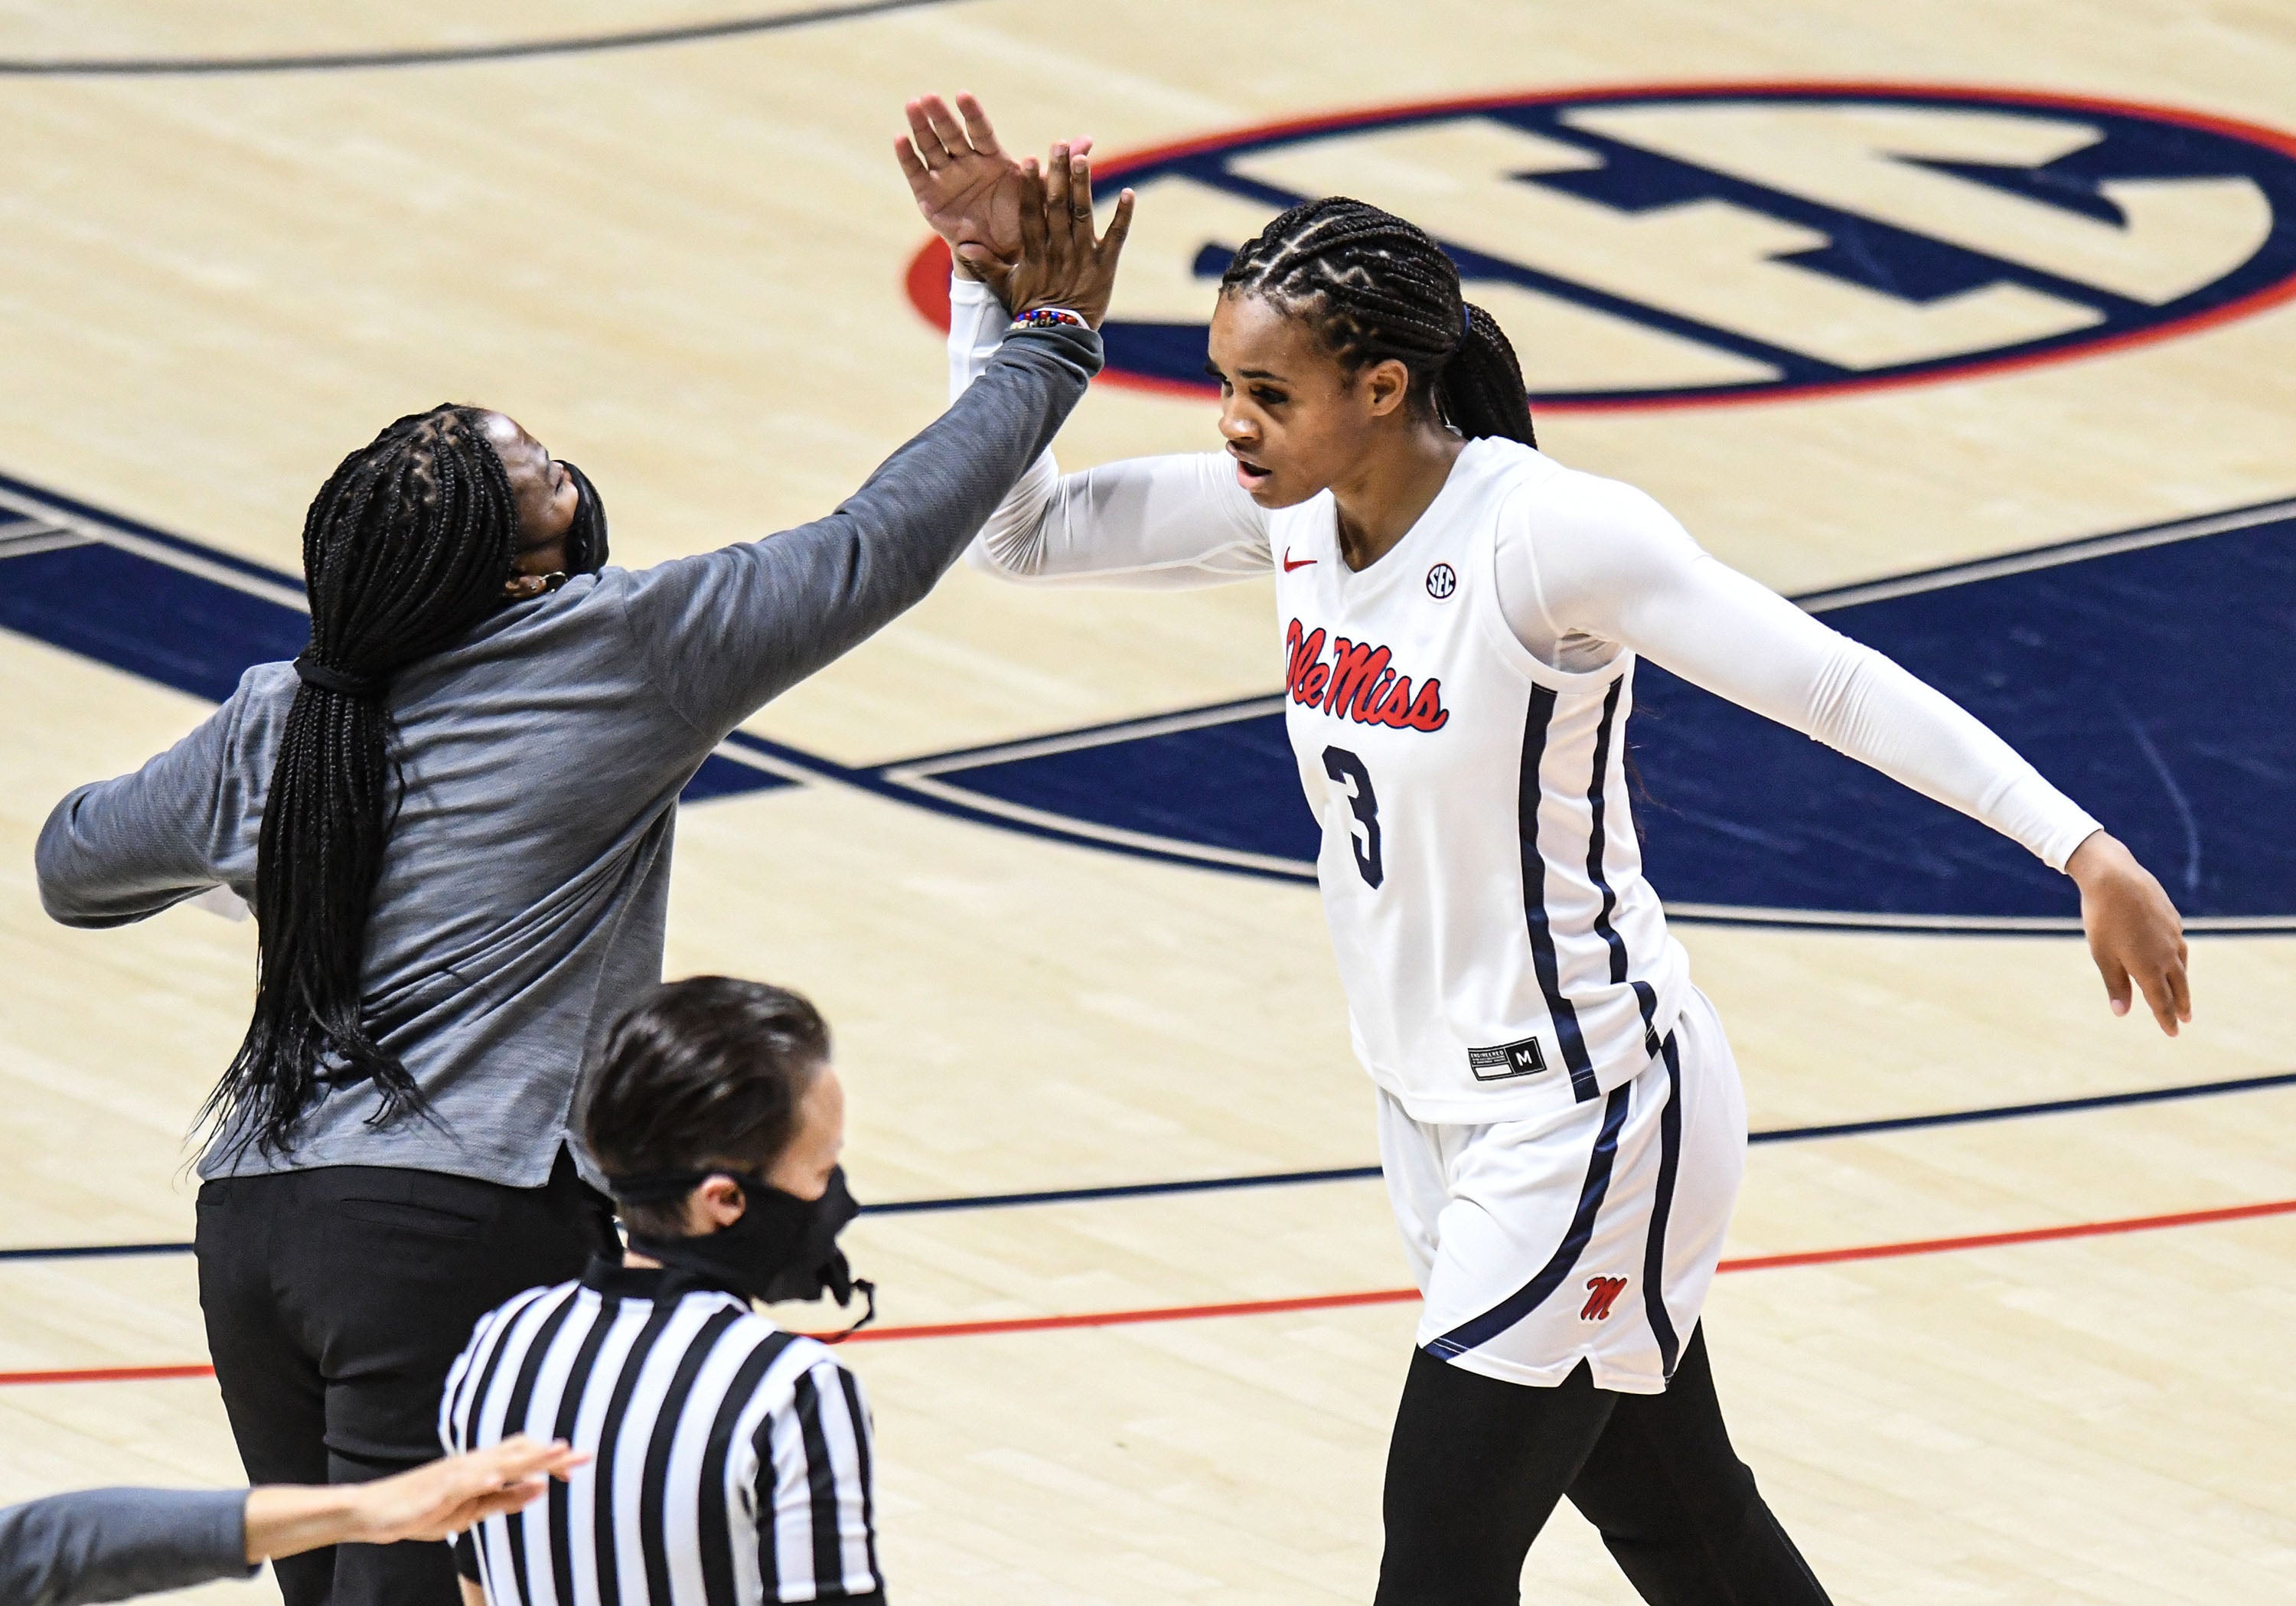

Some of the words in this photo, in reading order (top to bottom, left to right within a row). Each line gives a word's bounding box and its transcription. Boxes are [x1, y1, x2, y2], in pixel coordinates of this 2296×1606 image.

[1427, 564, 1455, 598] SEC
[1323, 636, 1450, 733] Miss
[1322, 745, 1384, 890] 3
[1515, 1049, 1532, 1066] M
[1580, 1276, 1628, 1320] M
